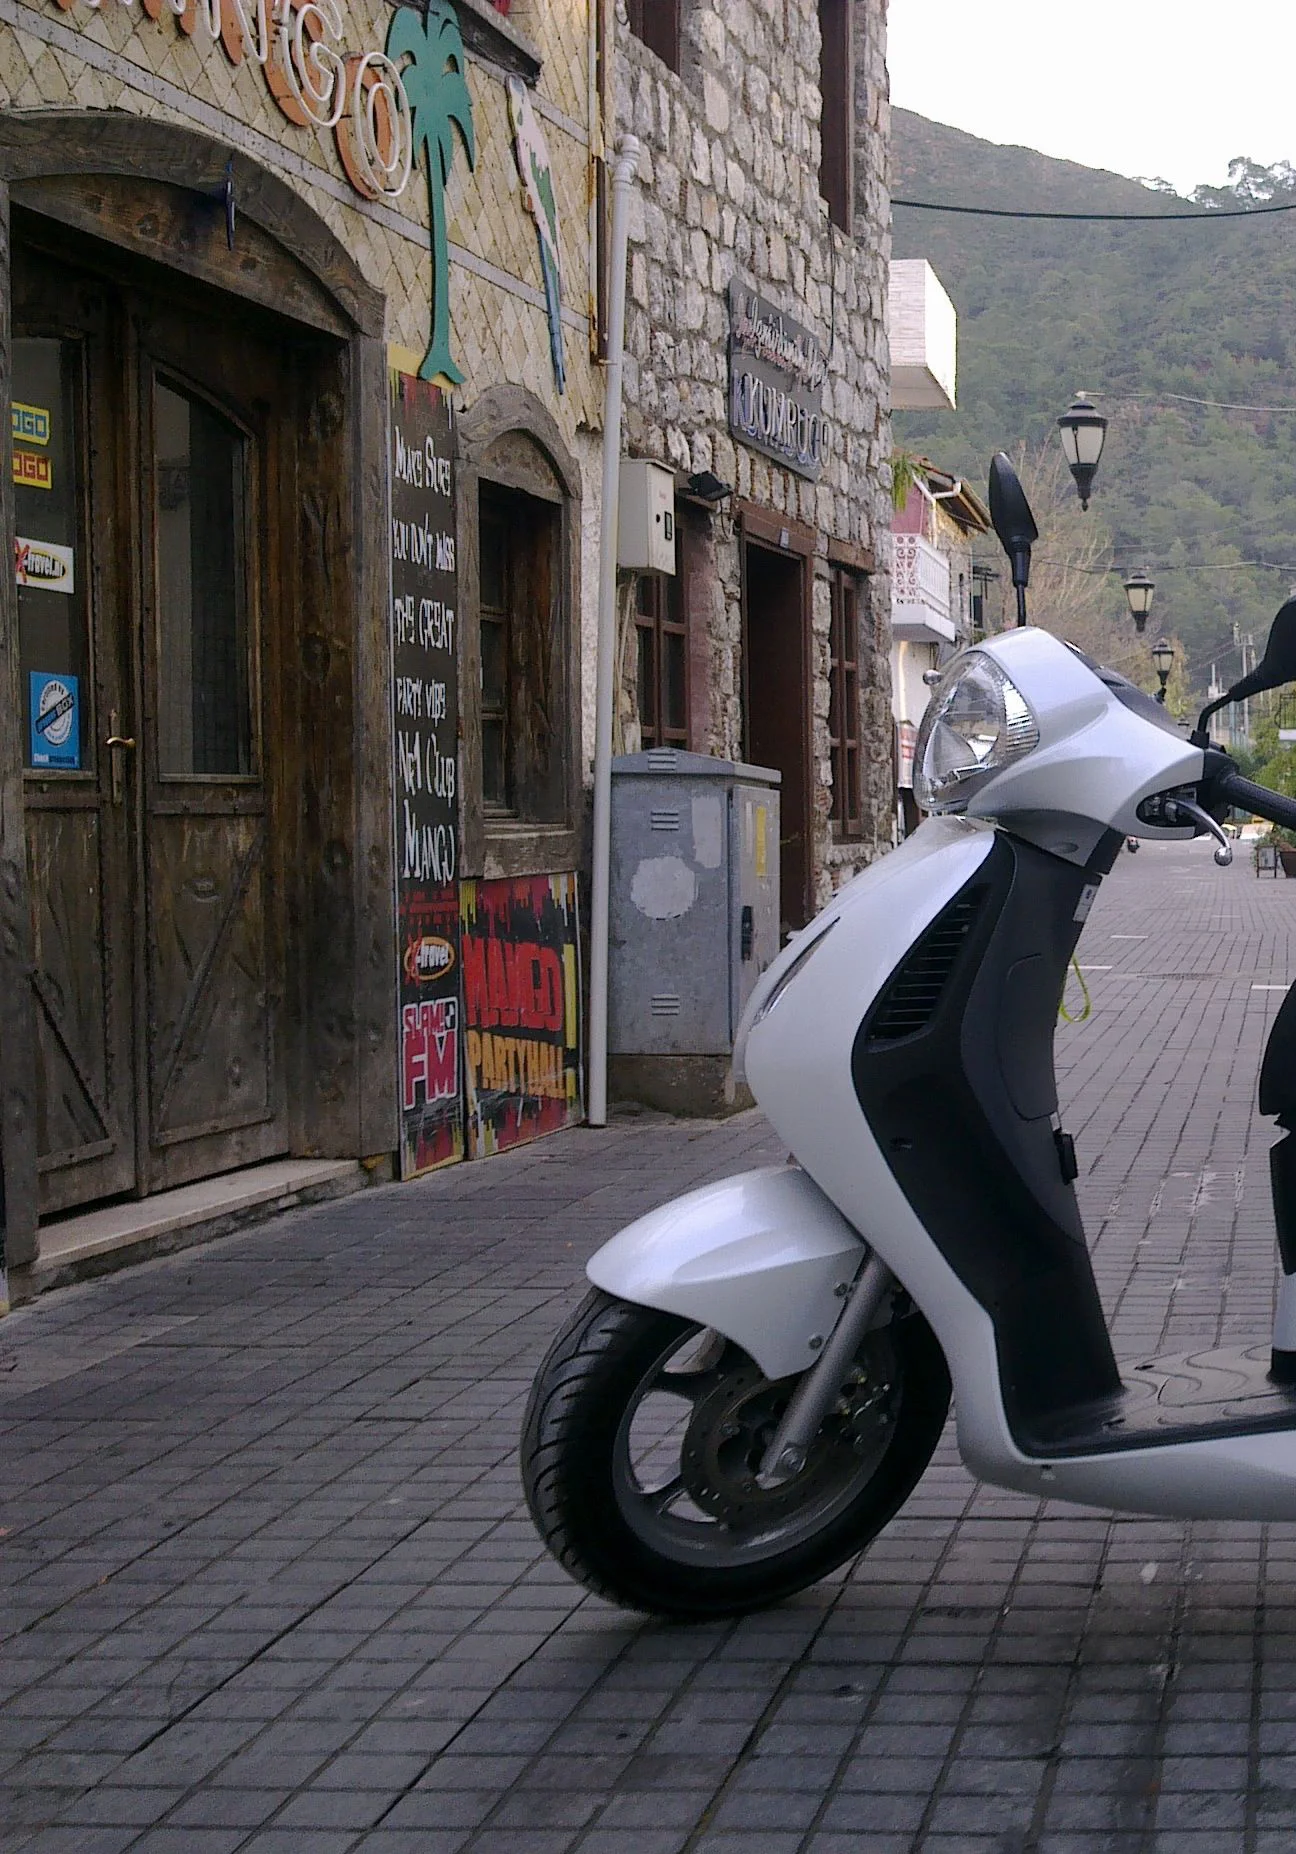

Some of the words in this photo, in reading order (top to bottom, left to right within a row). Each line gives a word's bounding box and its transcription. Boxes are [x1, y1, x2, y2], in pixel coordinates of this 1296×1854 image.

[394, 425, 423, 489] MAKE
[425, 435, 451, 497] SURE
[394, 594, 415, 647] THE
[419, 598, 455, 656] GREAT
[396, 676, 423, 720] PARTY
[426, 732, 455, 808] CLUB
[402, 799, 455, 888] MANGO
[402, 1030, 458, 1110] FM
